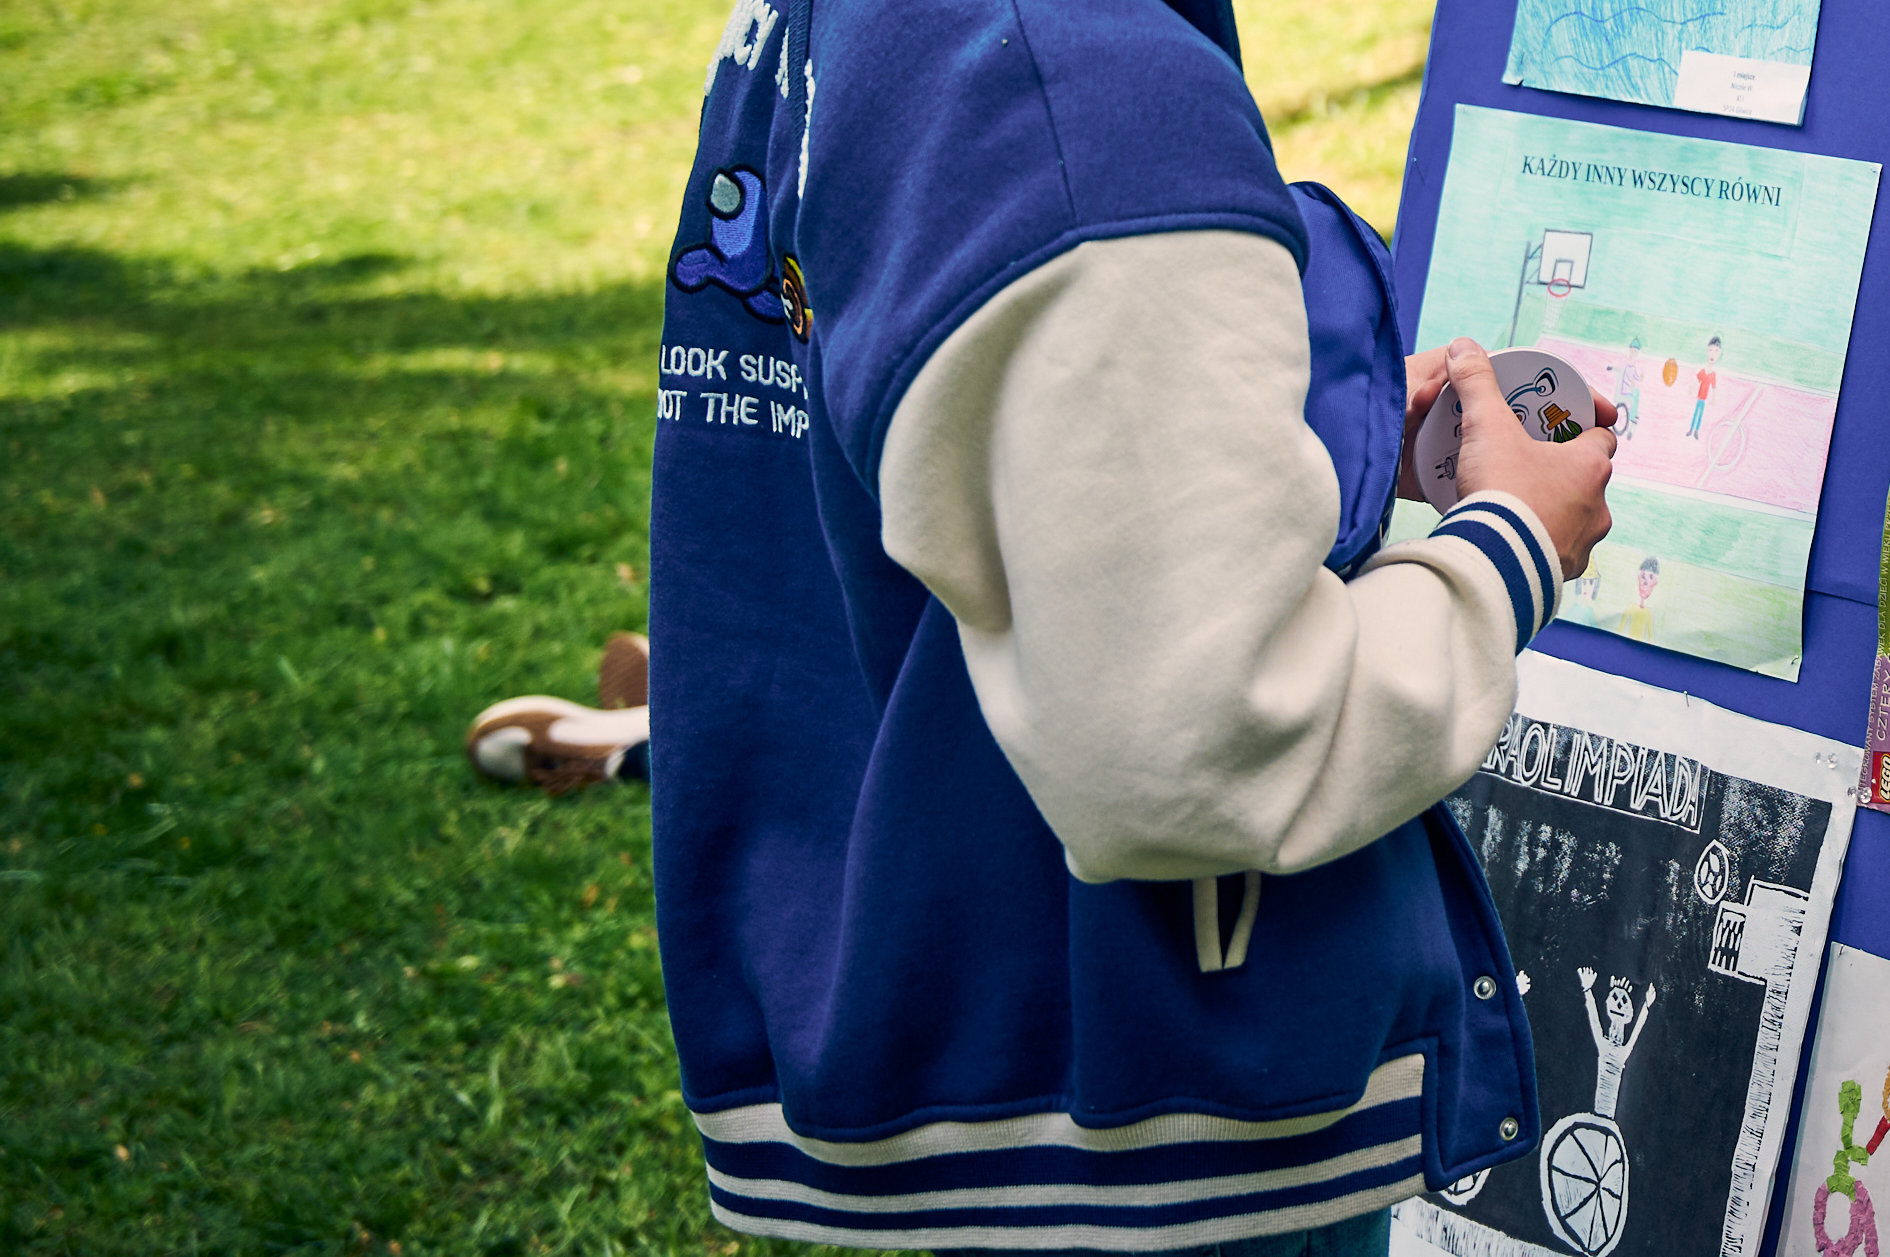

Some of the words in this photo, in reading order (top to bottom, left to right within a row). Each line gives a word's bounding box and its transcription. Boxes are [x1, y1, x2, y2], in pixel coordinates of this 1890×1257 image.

[1736, 72, 1756, 81] miejsce
[1522, 154, 1583, 181] KAŻDY
[1585, 163, 1628, 187] INNY
[1631, 168, 1716, 198] WSZYSCY
[1718, 176, 1783, 207] RÓWNI
[660, 344, 729, 381] LOOK
[700, 392, 759, 425] THE
[1880, 533, 1890, 563] WIEKU
[1880, 565, 1888, 574] W
[1876, 576, 1889, 607] DZIECI
[1876, 610, 1887, 629] DLA
[1872, 632, 1885, 680] ZABAWEK
[1867, 682, 1879, 723] SYSTEM
